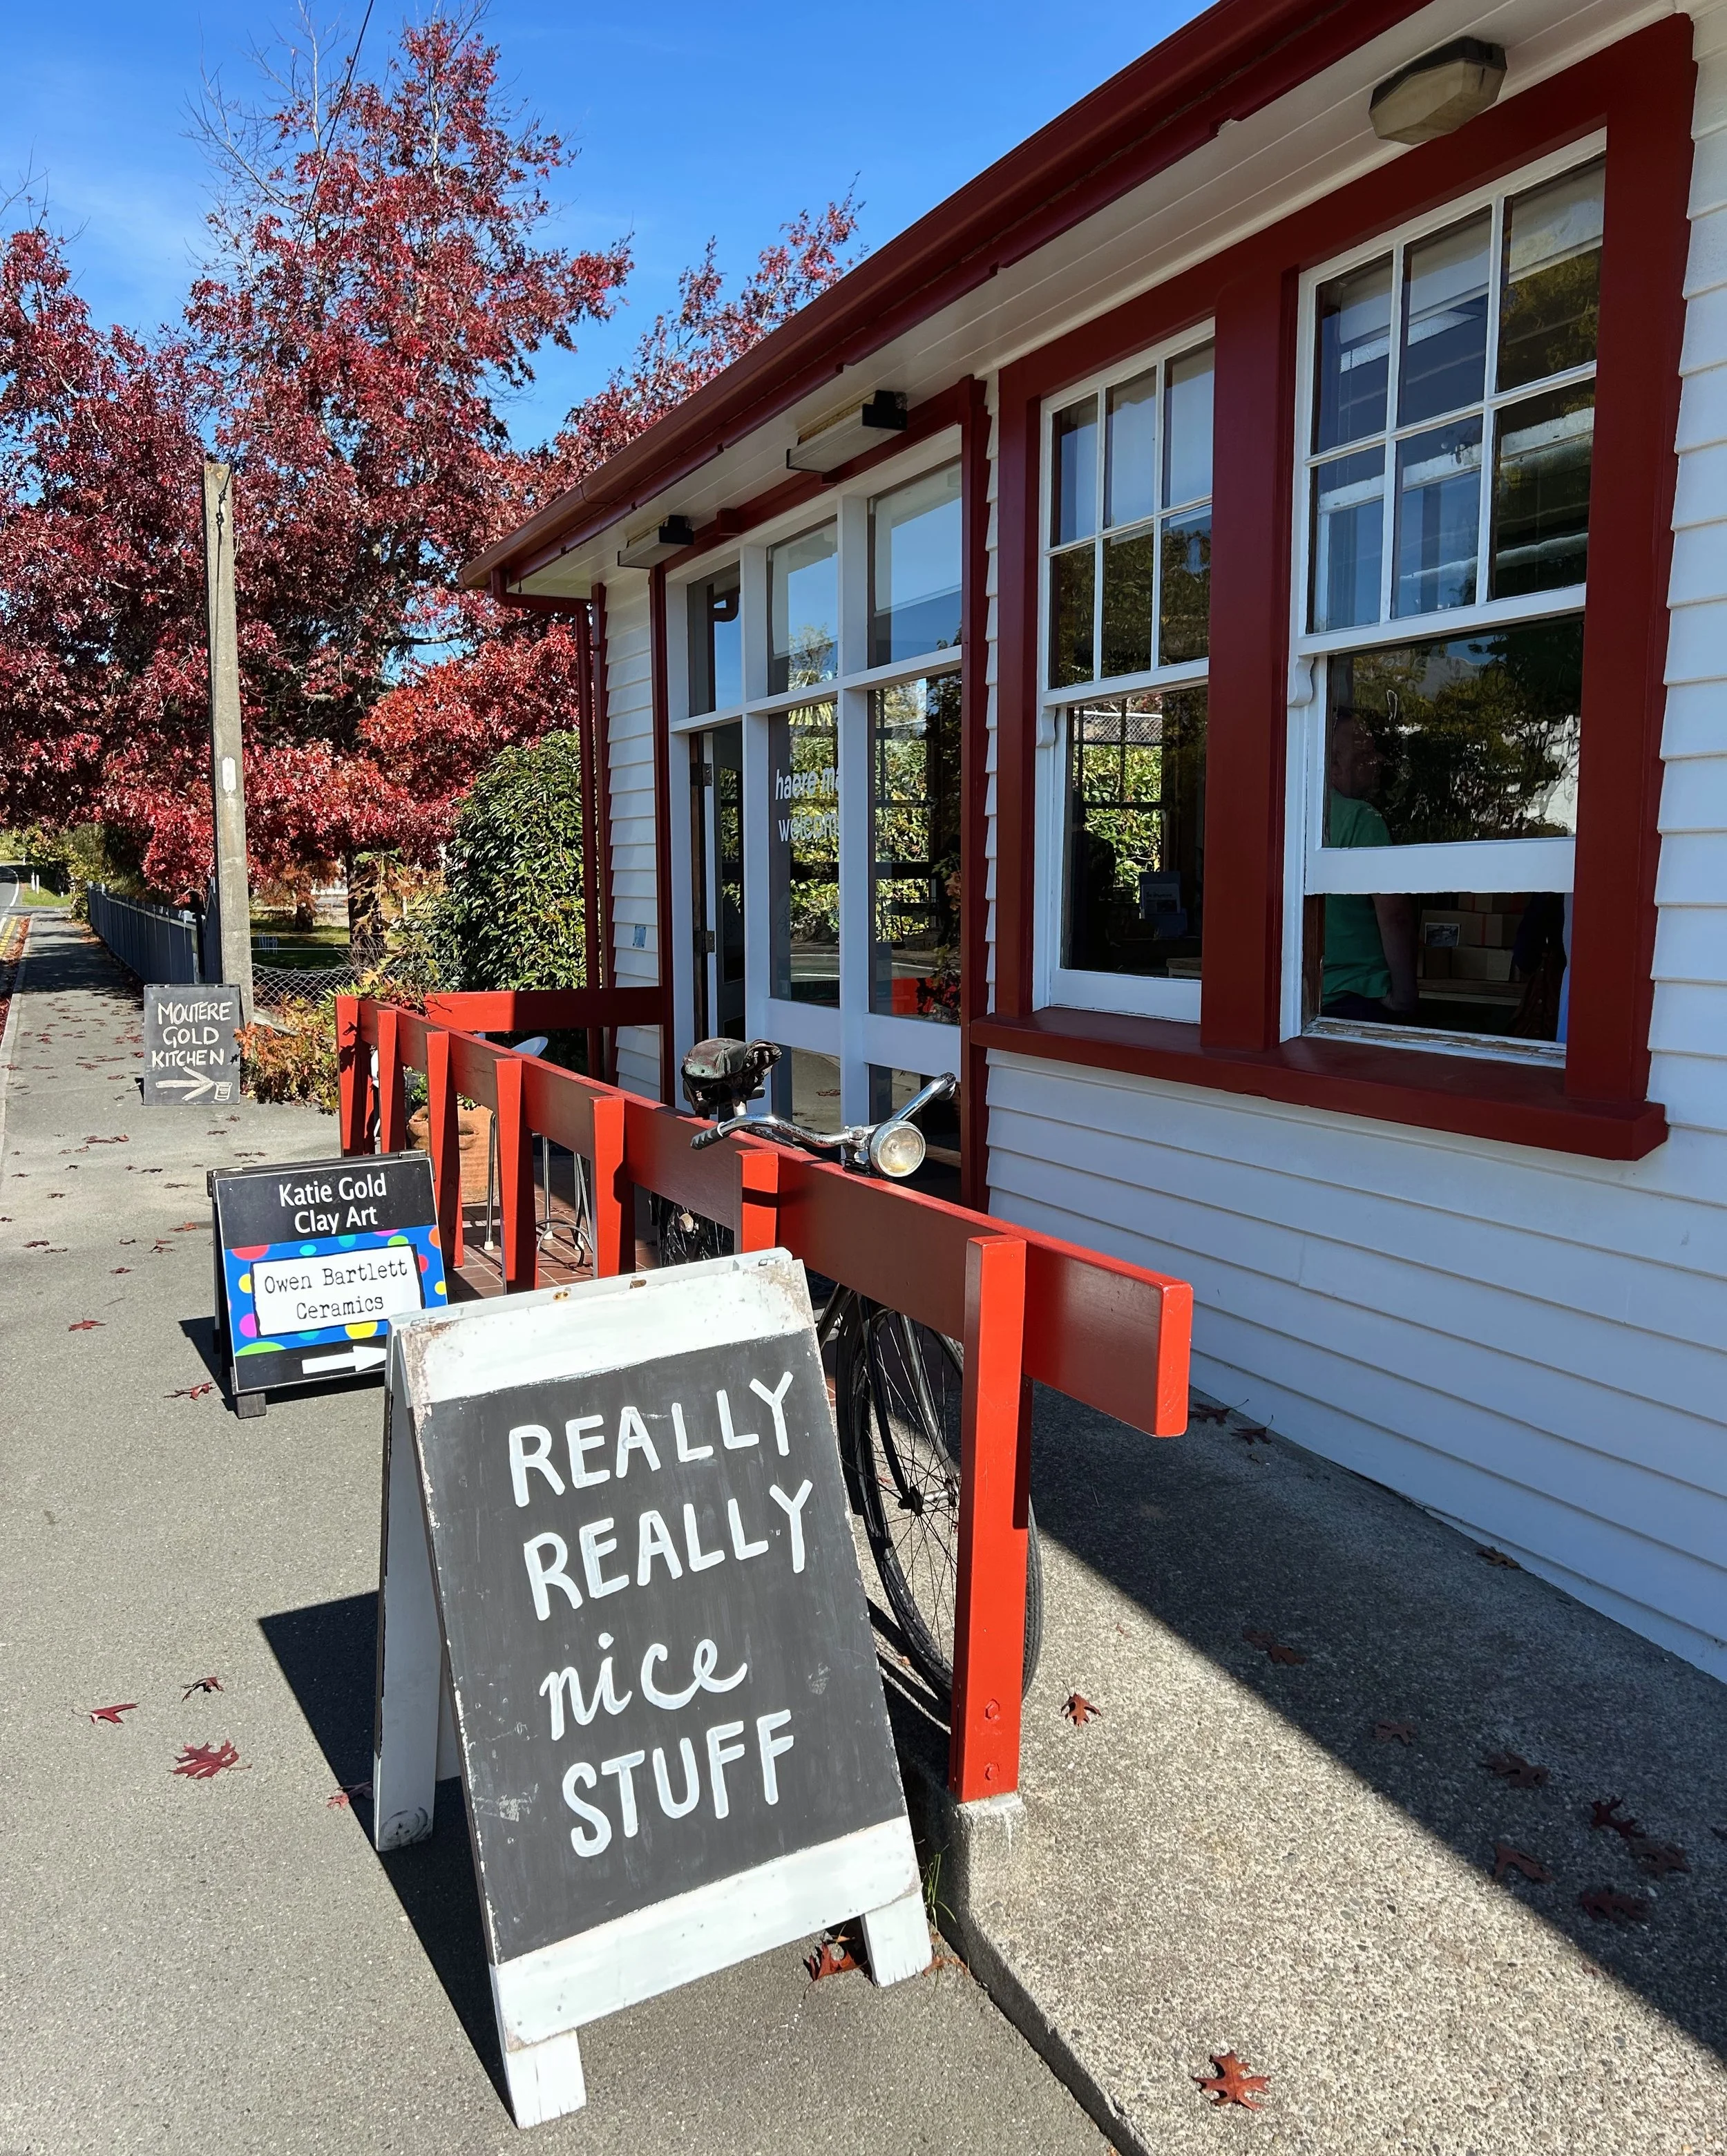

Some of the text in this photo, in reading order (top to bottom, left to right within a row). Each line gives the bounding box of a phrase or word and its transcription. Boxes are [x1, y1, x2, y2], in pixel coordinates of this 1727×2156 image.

[775, 769, 818, 801] haere
[779, 807, 839, 841] welcom
[158, 1001, 233, 1025] MOUTERE
[162, 1026, 220, 1049] GOLD
[151, 1048, 225, 1068] KITCHEN
[278, 1173, 387, 1207] Katie Gold
[294, 1205, 378, 1234] Clay Art
[264, 1259, 408, 1294] Owen Bartlett
[296, 1295, 384, 1320] Ceramics
[509, 1371, 793, 1507] REALLY
[524, 1479, 813, 1621] REALLY
[539, 1632, 747, 1741] nice
[562, 1709, 794, 1858] STUFF
